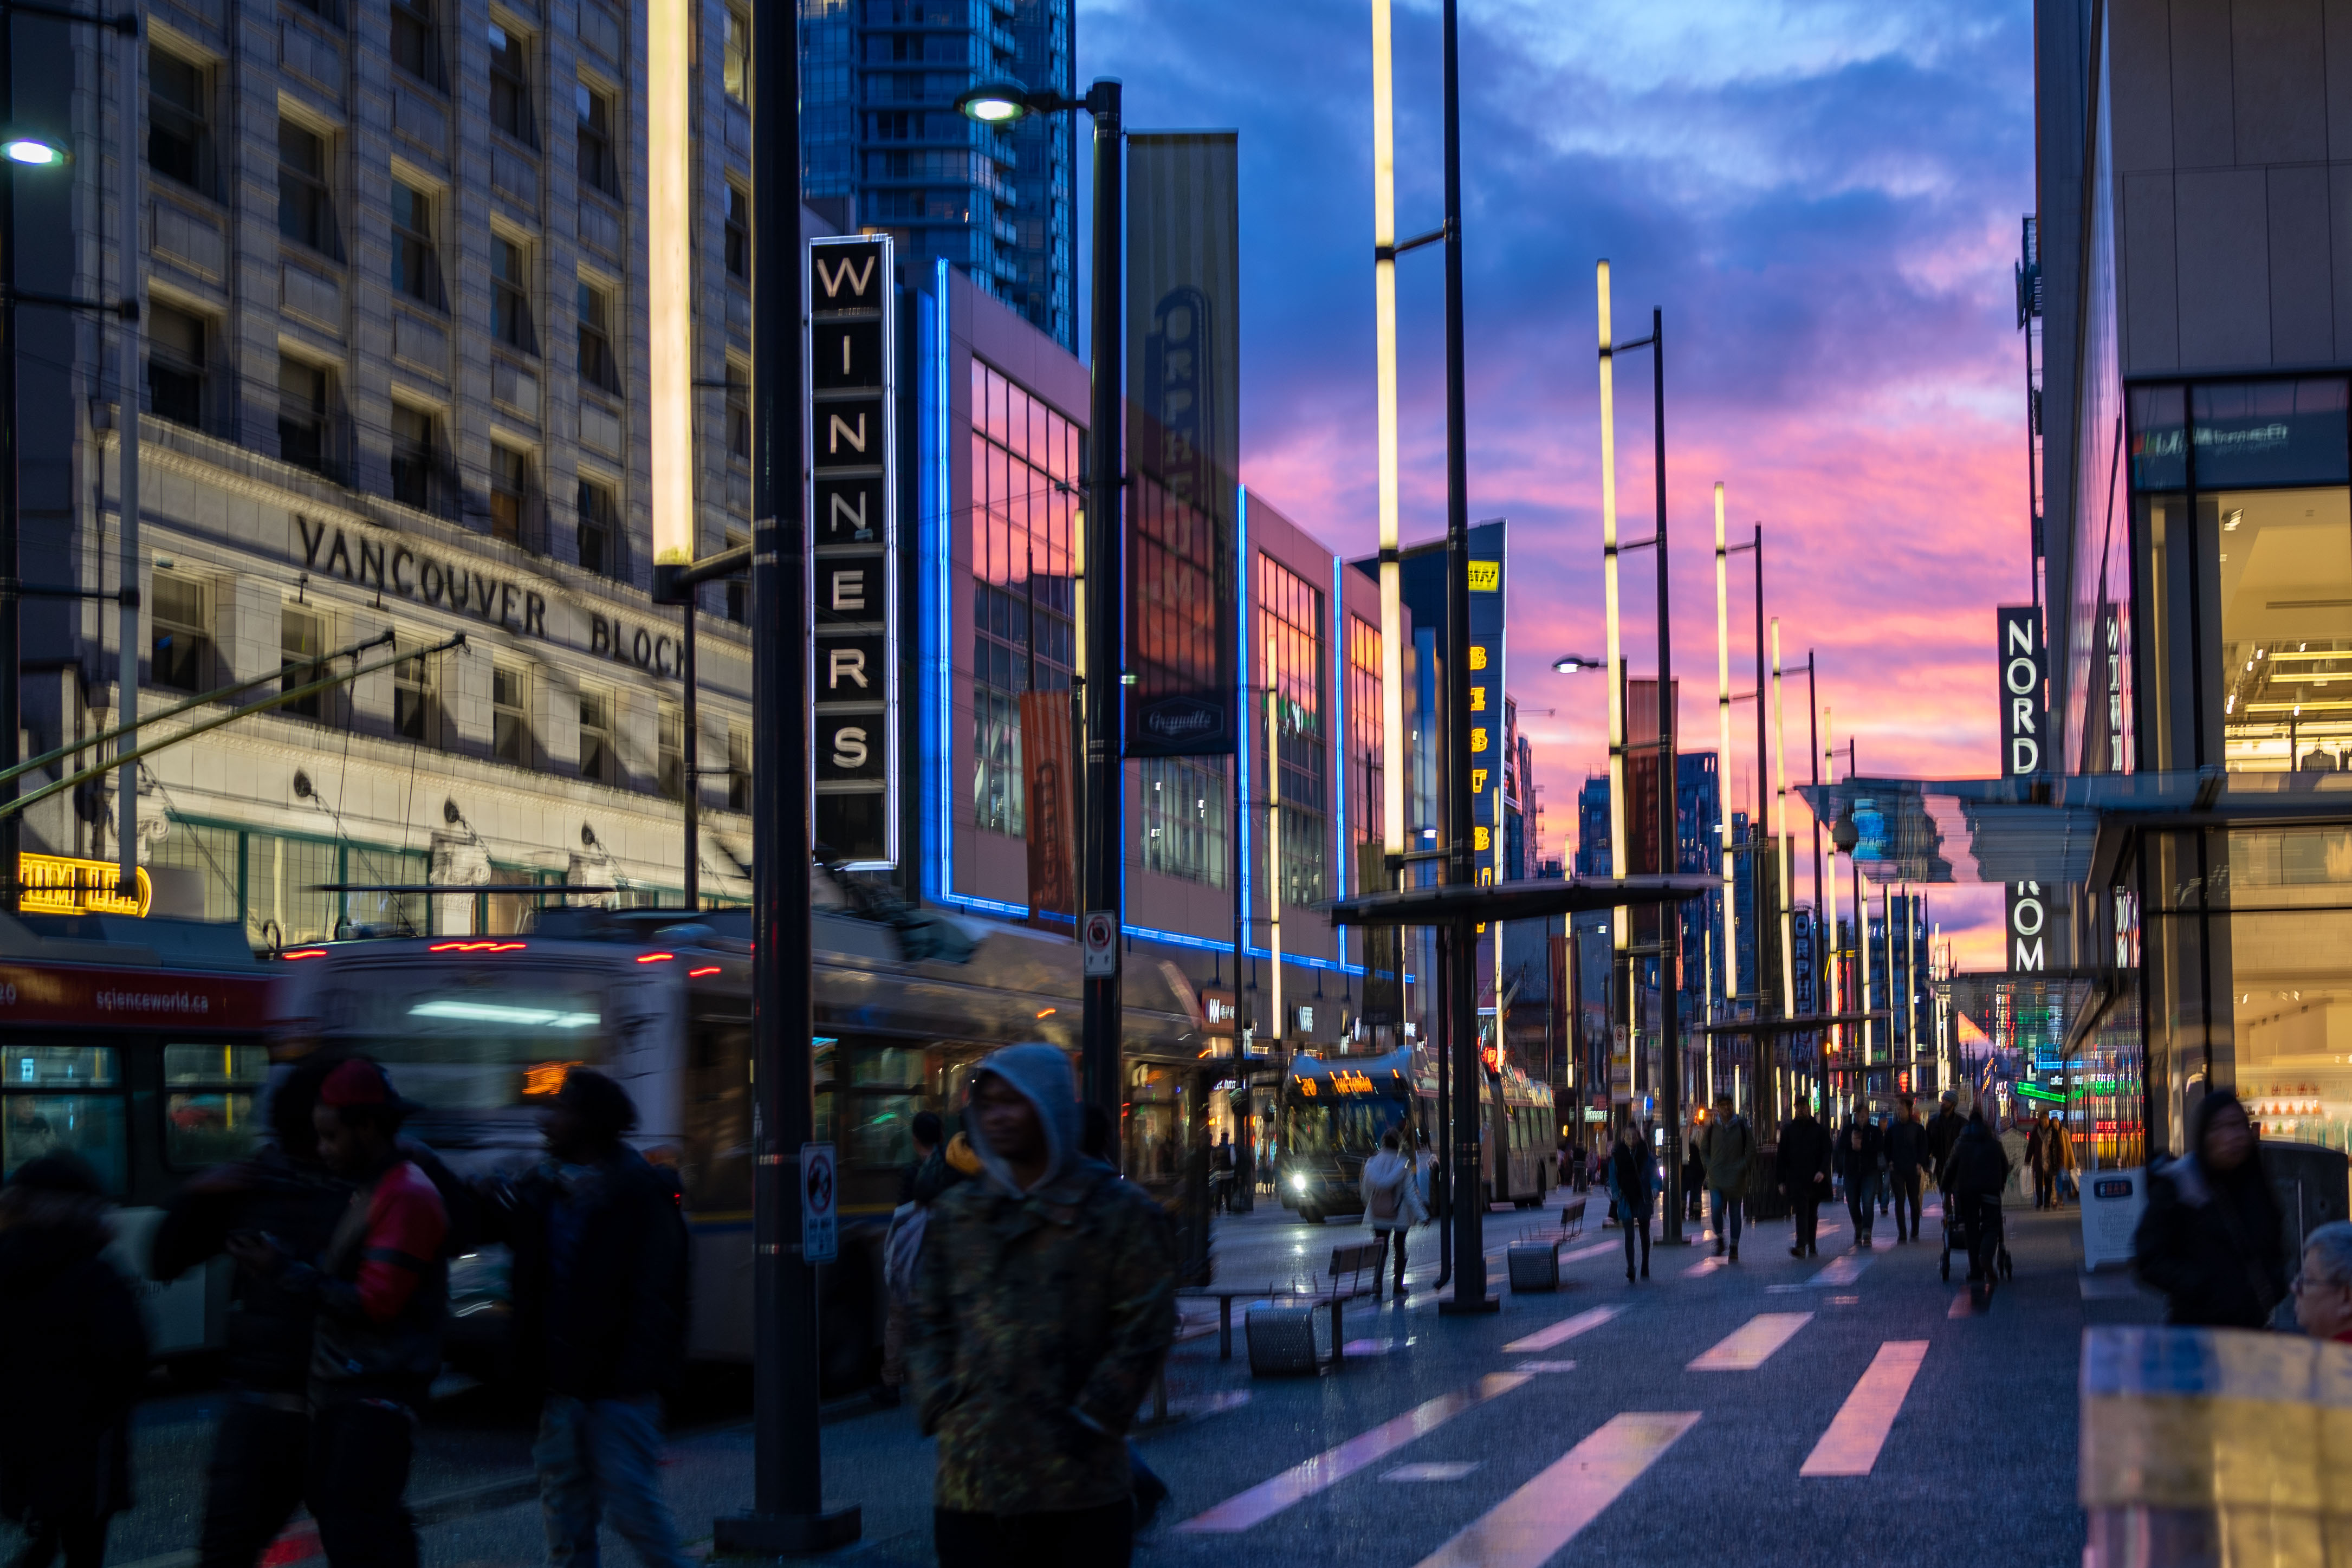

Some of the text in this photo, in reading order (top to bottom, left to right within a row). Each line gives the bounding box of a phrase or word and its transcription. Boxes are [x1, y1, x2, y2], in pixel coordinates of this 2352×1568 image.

[295, 515, 546, 639] VANCOUVER
[817, 256, 876, 768] WINNERS
[2007, 619, 2044, 971] NORDOM
[96, 988, 209, 1014] scienceworld.ca
